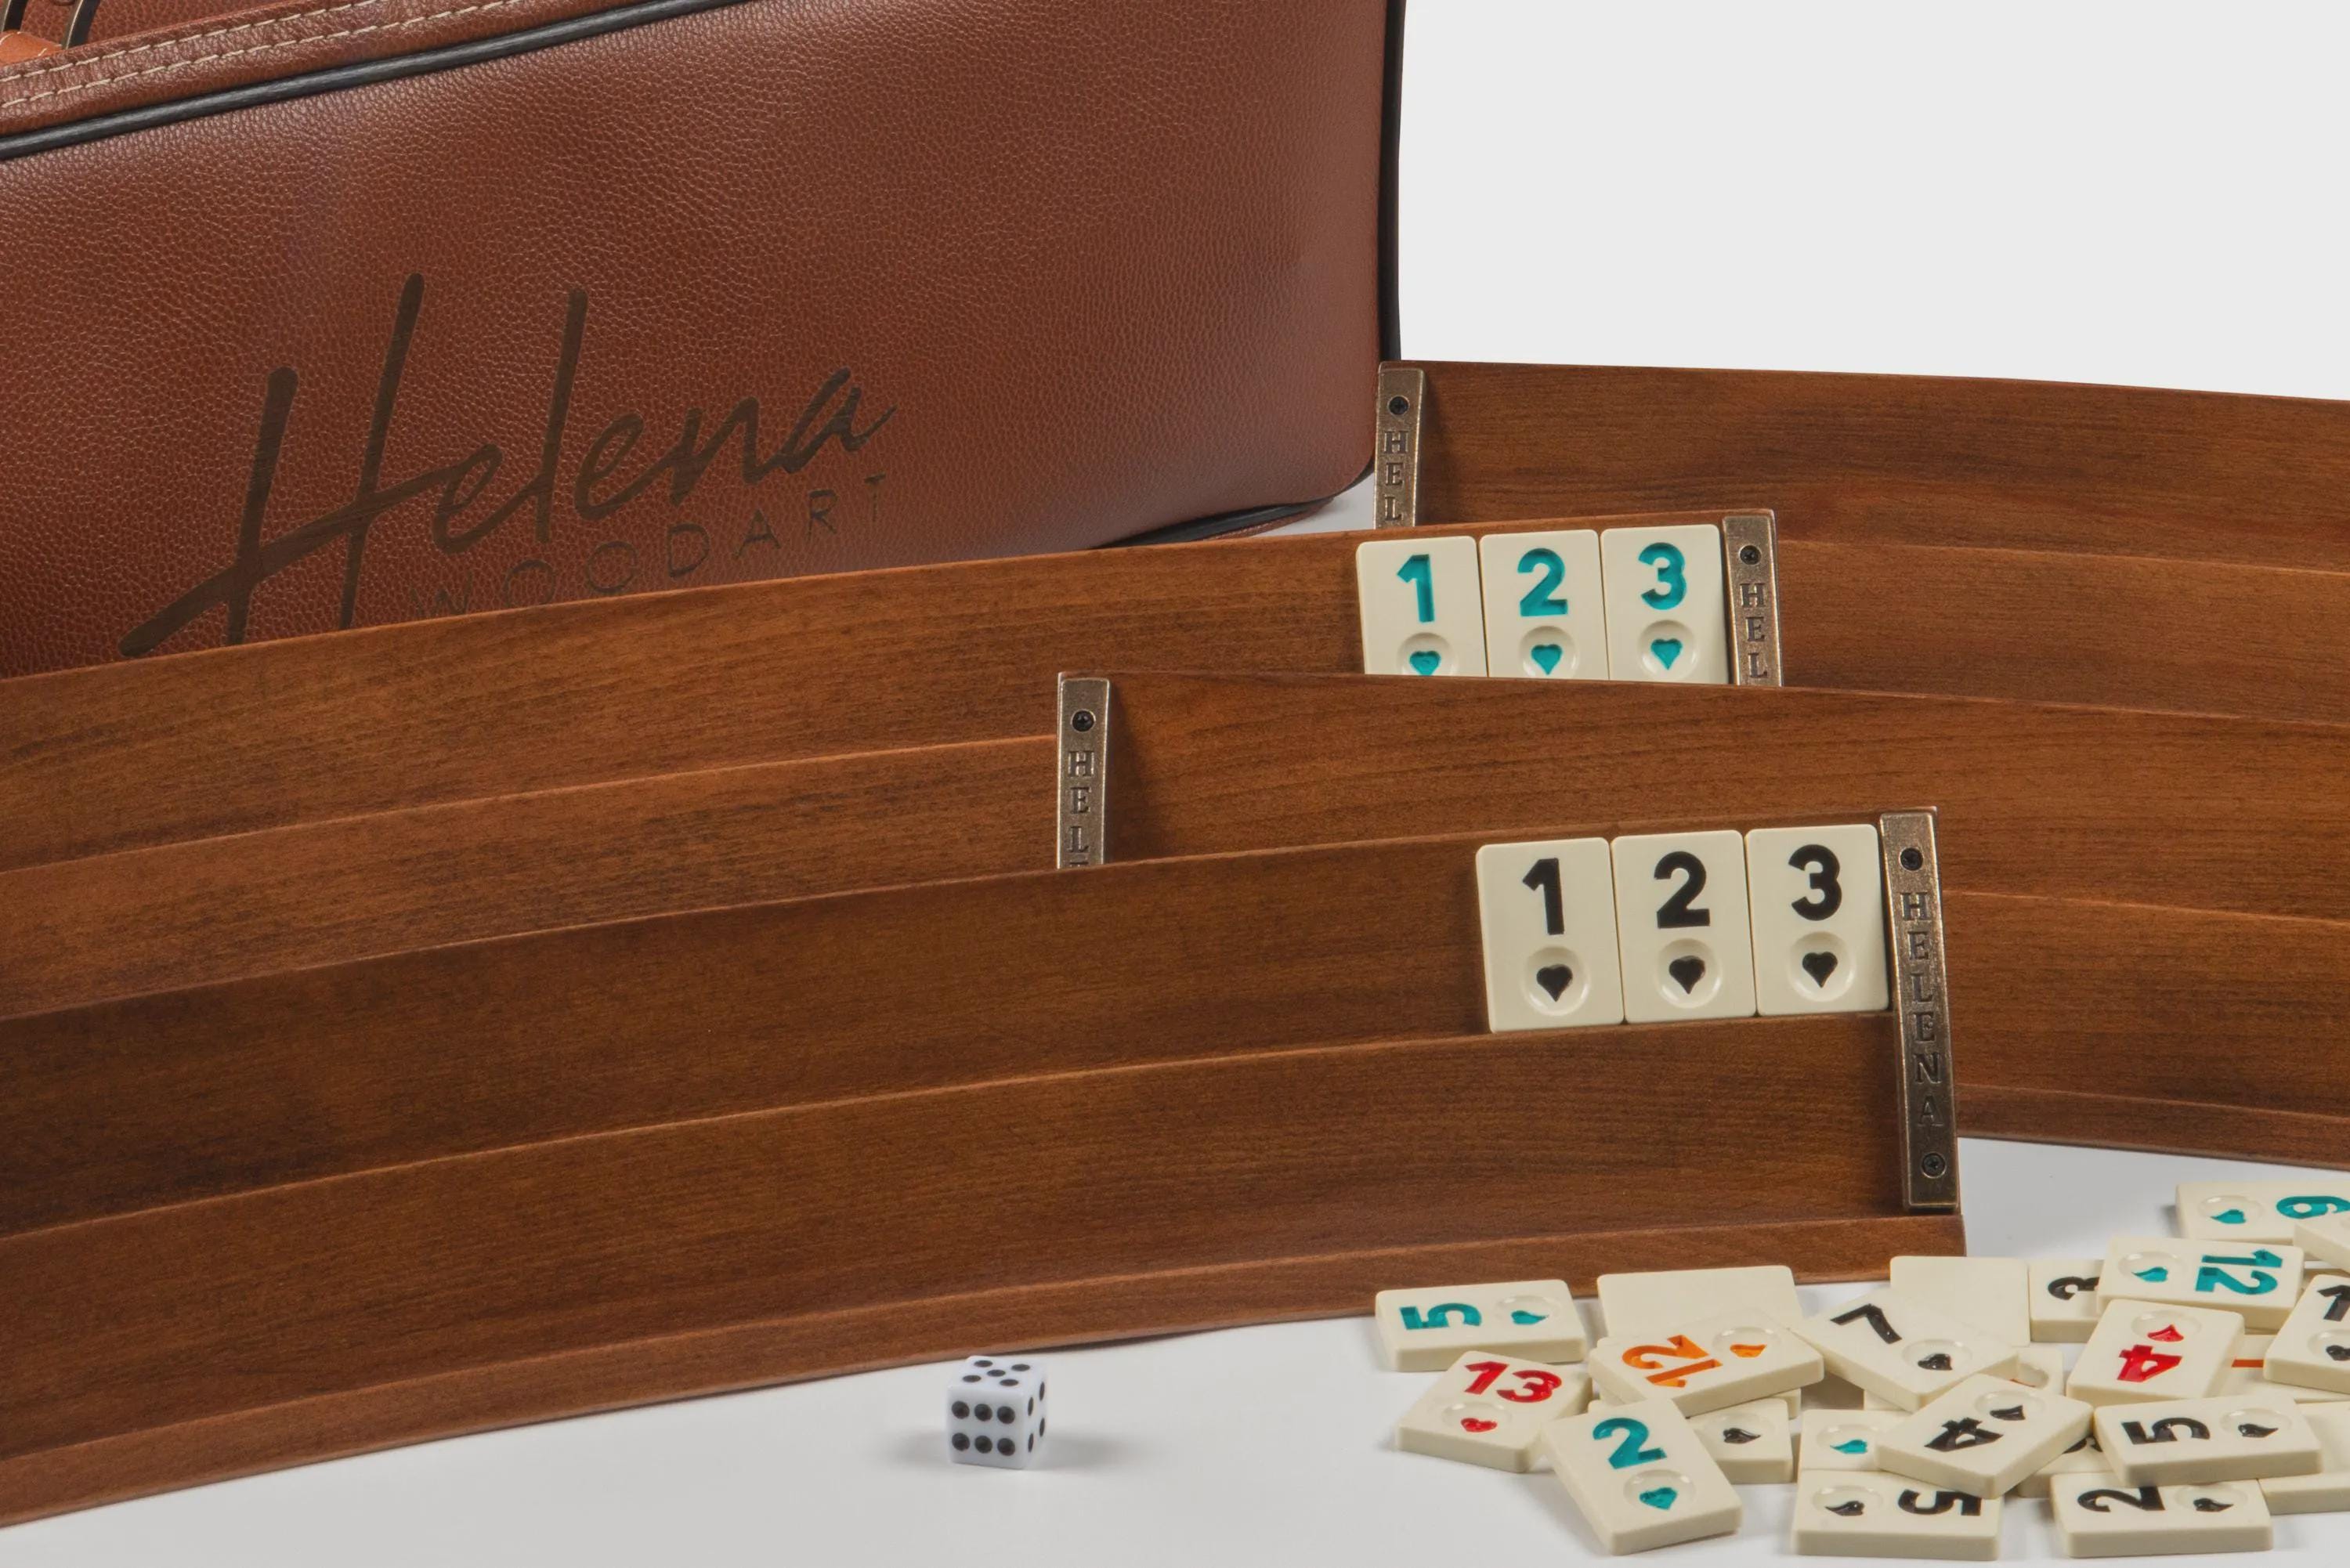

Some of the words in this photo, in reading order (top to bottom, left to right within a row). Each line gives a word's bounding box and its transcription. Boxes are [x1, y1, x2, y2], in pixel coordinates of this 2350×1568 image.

[119, 273, 895, 656] Helena
[1383, 432, 1408, 521] HEL
[1397, 554, 1434, 623] 1
[1517, 547, 1567, 616] 2
[1638, 542, 1687, 610] 3
[1740, 583, 1767, 677] HEL
[1068, 751, 1094, 867] HEL
[1522, 858, 1564, 935] 1
[1654, 851, 1710, 929] 2
[1788, 844, 1842, 921] 3
[1900, 892, 1943, 1126] HELENA
[2196, 1248, 2283, 1295] 12
[1400, 1302, 1481, 1330] 5
[1830, 1303, 1901, 1344] 7
[1464, 1361, 1562, 1403] 13
[1622, 1335, 1723, 1388] 12
[2117, 1345, 2183, 1382] 4
[1593, 1418, 1666, 1469] 2
[1924, 1417, 2004, 1453] 4
[2122, 1417, 2210, 1445] 5
[1898, 1490, 1982, 1516] 5
[2077, 1485, 2165, 1512] 2
